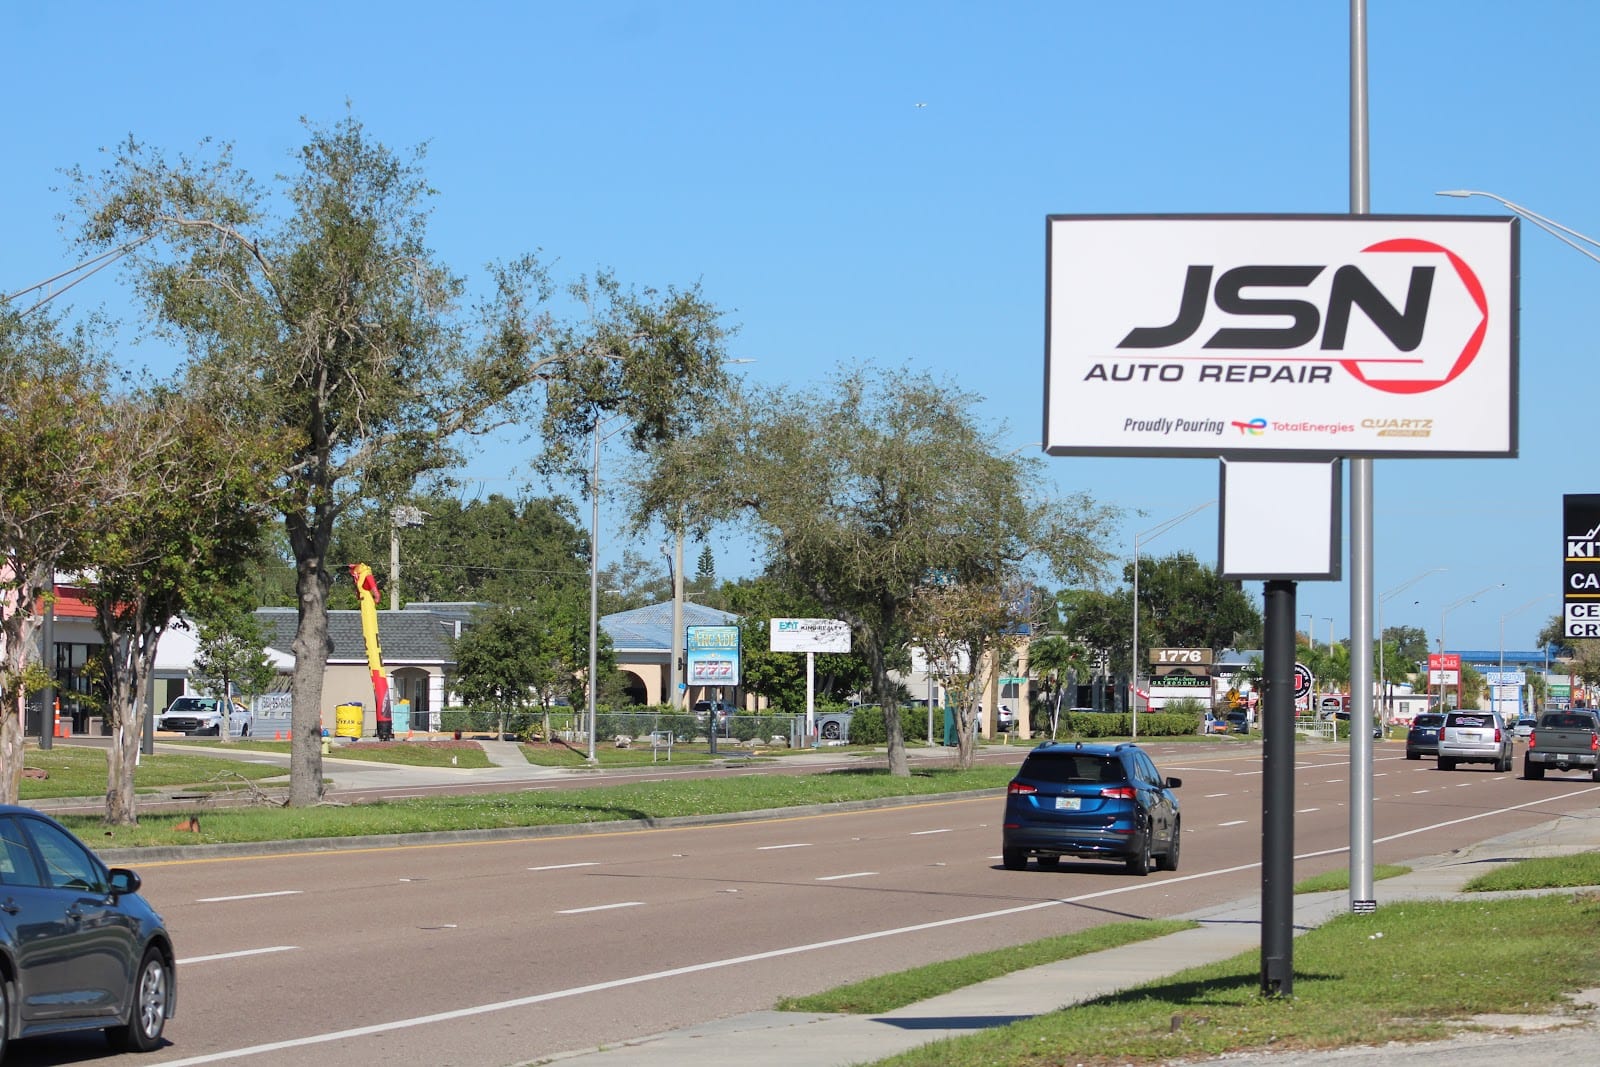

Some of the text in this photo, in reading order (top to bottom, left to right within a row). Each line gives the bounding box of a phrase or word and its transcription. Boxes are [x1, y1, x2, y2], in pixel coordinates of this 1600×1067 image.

[1115, 263, 1437, 353] JSN
[1083, 363, 1333, 384] AUTO REPAIR
[1124, 417, 1225, 436] Proudly Pouring
[1272, 421, 1355, 434] TotalEnergies
[1360, 418, 1433, 429] QUARTZ
[778, 621, 799, 630] EXIT
[1569, 623, 1600, 637] CR
[1159, 650, 1202, 663] 1776
